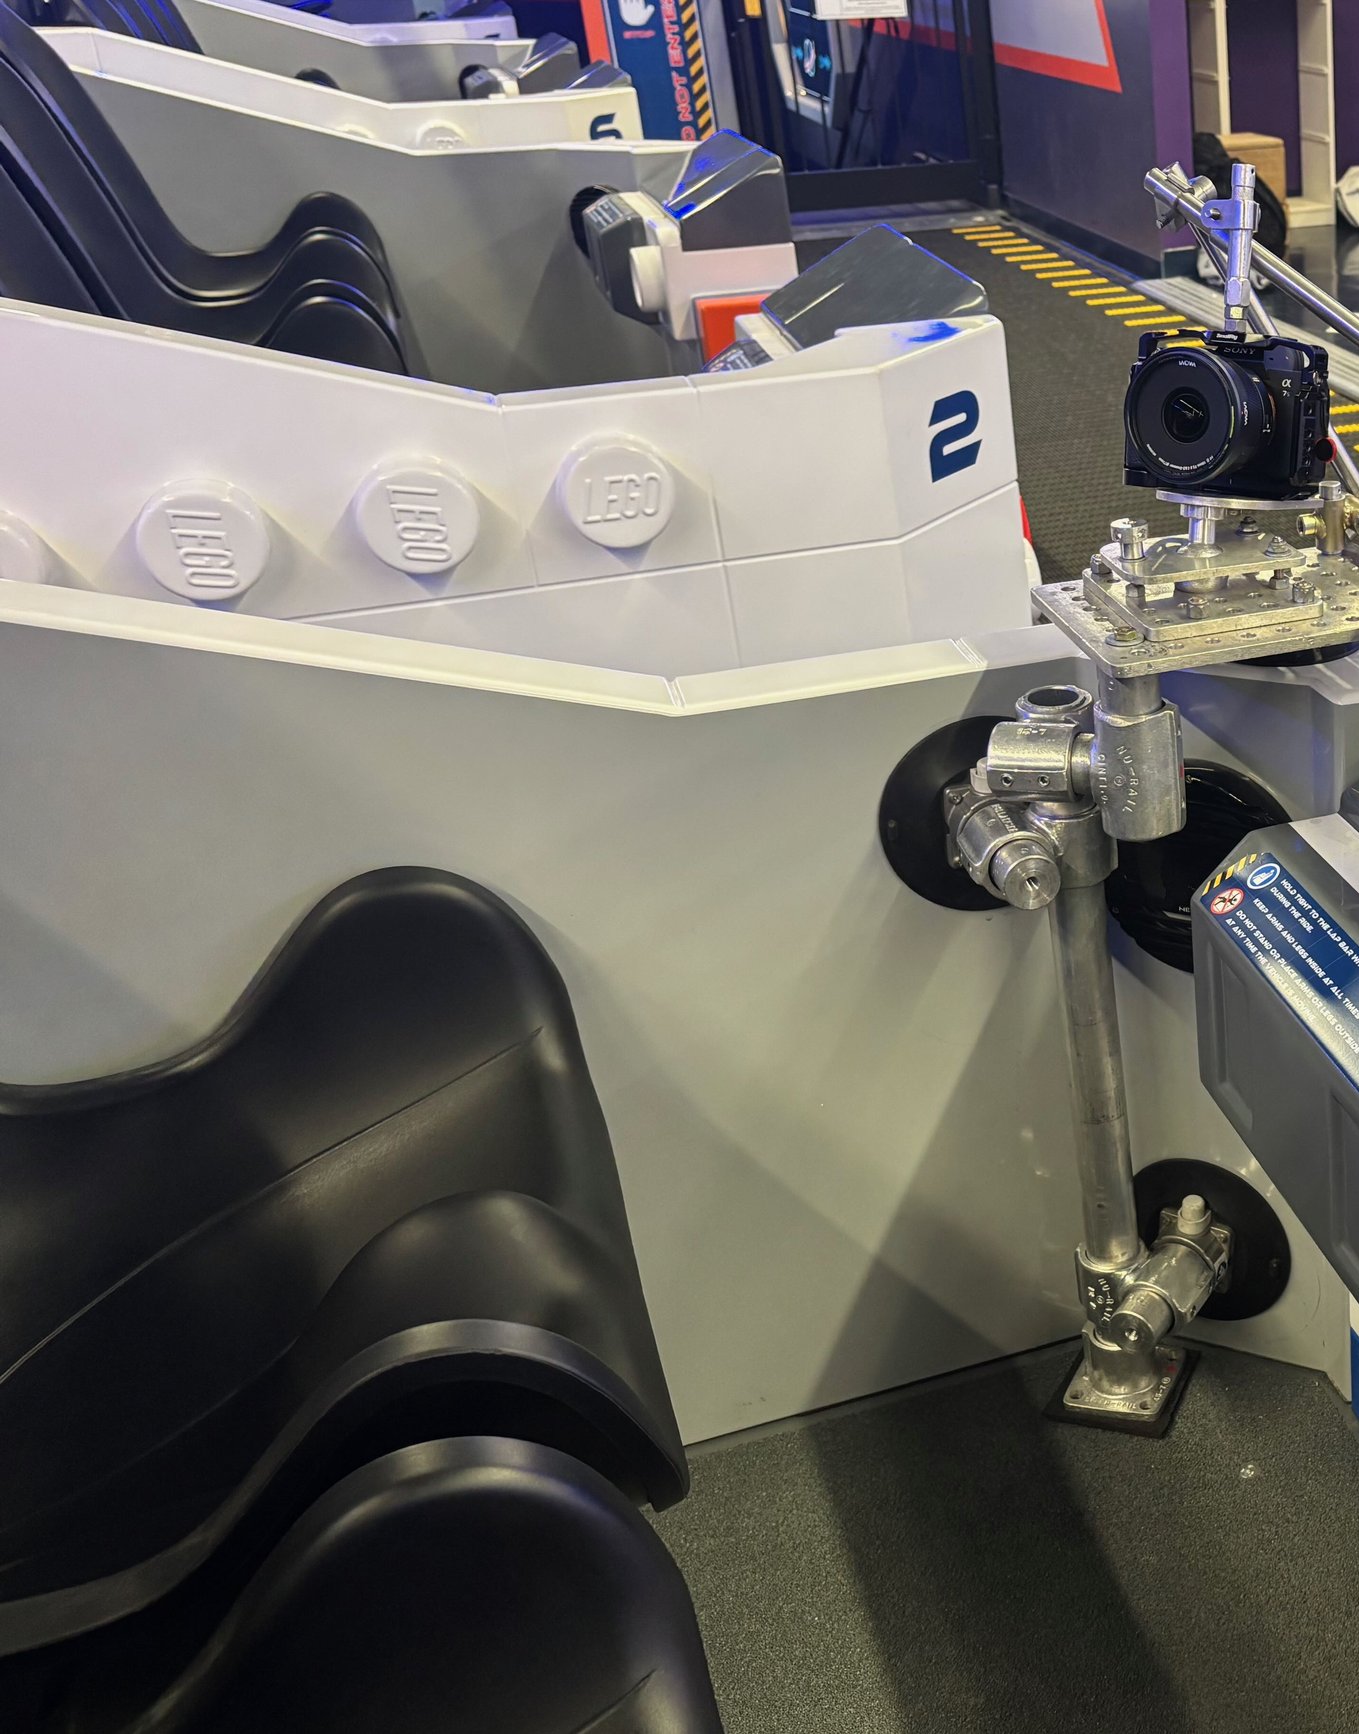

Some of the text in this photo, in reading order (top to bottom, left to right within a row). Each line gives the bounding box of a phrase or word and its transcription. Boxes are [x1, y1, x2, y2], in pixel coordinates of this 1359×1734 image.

[671, 71, 693, 121] NOT
[1223, 346, 1256, 355] SONY
[928, 389, 983, 483] 2
[386, 484, 453, 564] LEGO
[581, 472, 661, 524] LEGO
[165, 508, 240, 589] LEGO
[1225, 918, 1236, 926] AT
[1232, 926, 1246, 939] ANY
[1243, 938, 1258, 953] TIME
[1255, 951, 1268, 965] THE
[1253, 898, 1268, 913] KEEP
[1266, 913, 1284, 932] ARMS
[1281, 930, 1295, 944] AND
[1292, 941, 1309, 959] LEGS
[1306, 957, 1326, 978] INSIDE
[1322, 977, 1334, 986] AT
[1330, 986, 1344, 999] ALL
[1270, 887, 1314, 933] DURING THE RIDE.
[1280, 879, 1296, 895] HOLD
[1294, 893, 1312, 910] TIGHT
[1309, 909, 1320, 919] TO
[1316, 917, 1330, 930] THE
[1326, 928, 1342, 942] LAP
[1338, 941, 1354, 956] BAR
[1236, 910, 1246, 920] DO
[1243, 918, 1256, 931] NOT
[1254, 930, 1272, 949] STAND
[1270, 948, 1280, 960] OR
[1277, 958, 1298, 979] PLACE
[1295, 979, 1314, 998] ARMS
[1312, 998, 1323, 1009] OR
[1320, 1006, 1338, 1026] LEGS
